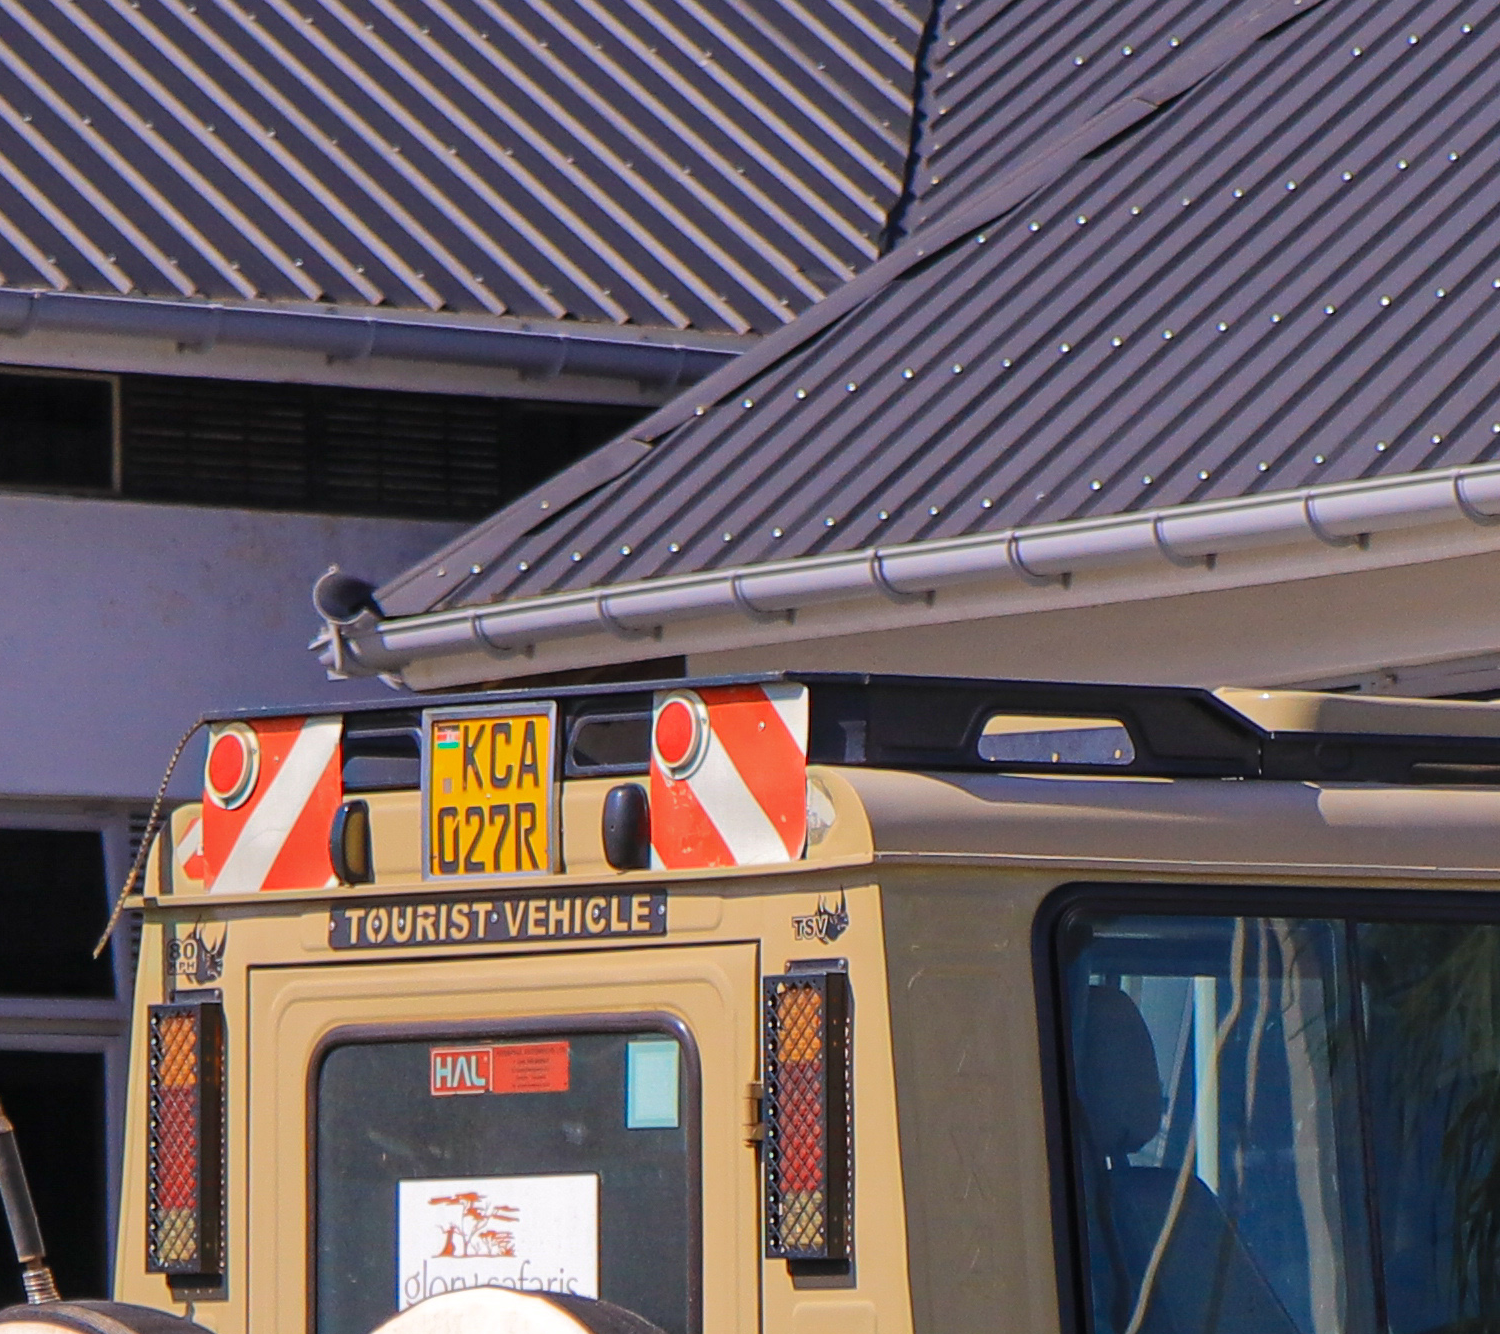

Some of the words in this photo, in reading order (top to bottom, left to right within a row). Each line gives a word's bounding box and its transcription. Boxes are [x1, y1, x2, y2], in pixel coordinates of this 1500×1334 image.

[464, 720, 540, 792] KCA
[438, 802, 540, 873] 027R
[345, 901, 493, 944] TOURIST
[504, 894, 651, 938] VEHICLE
[793, 916, 828, 940] TSV
[168, 940, 196, 961] 80
[435, 1055, 486, 1088] HAL
